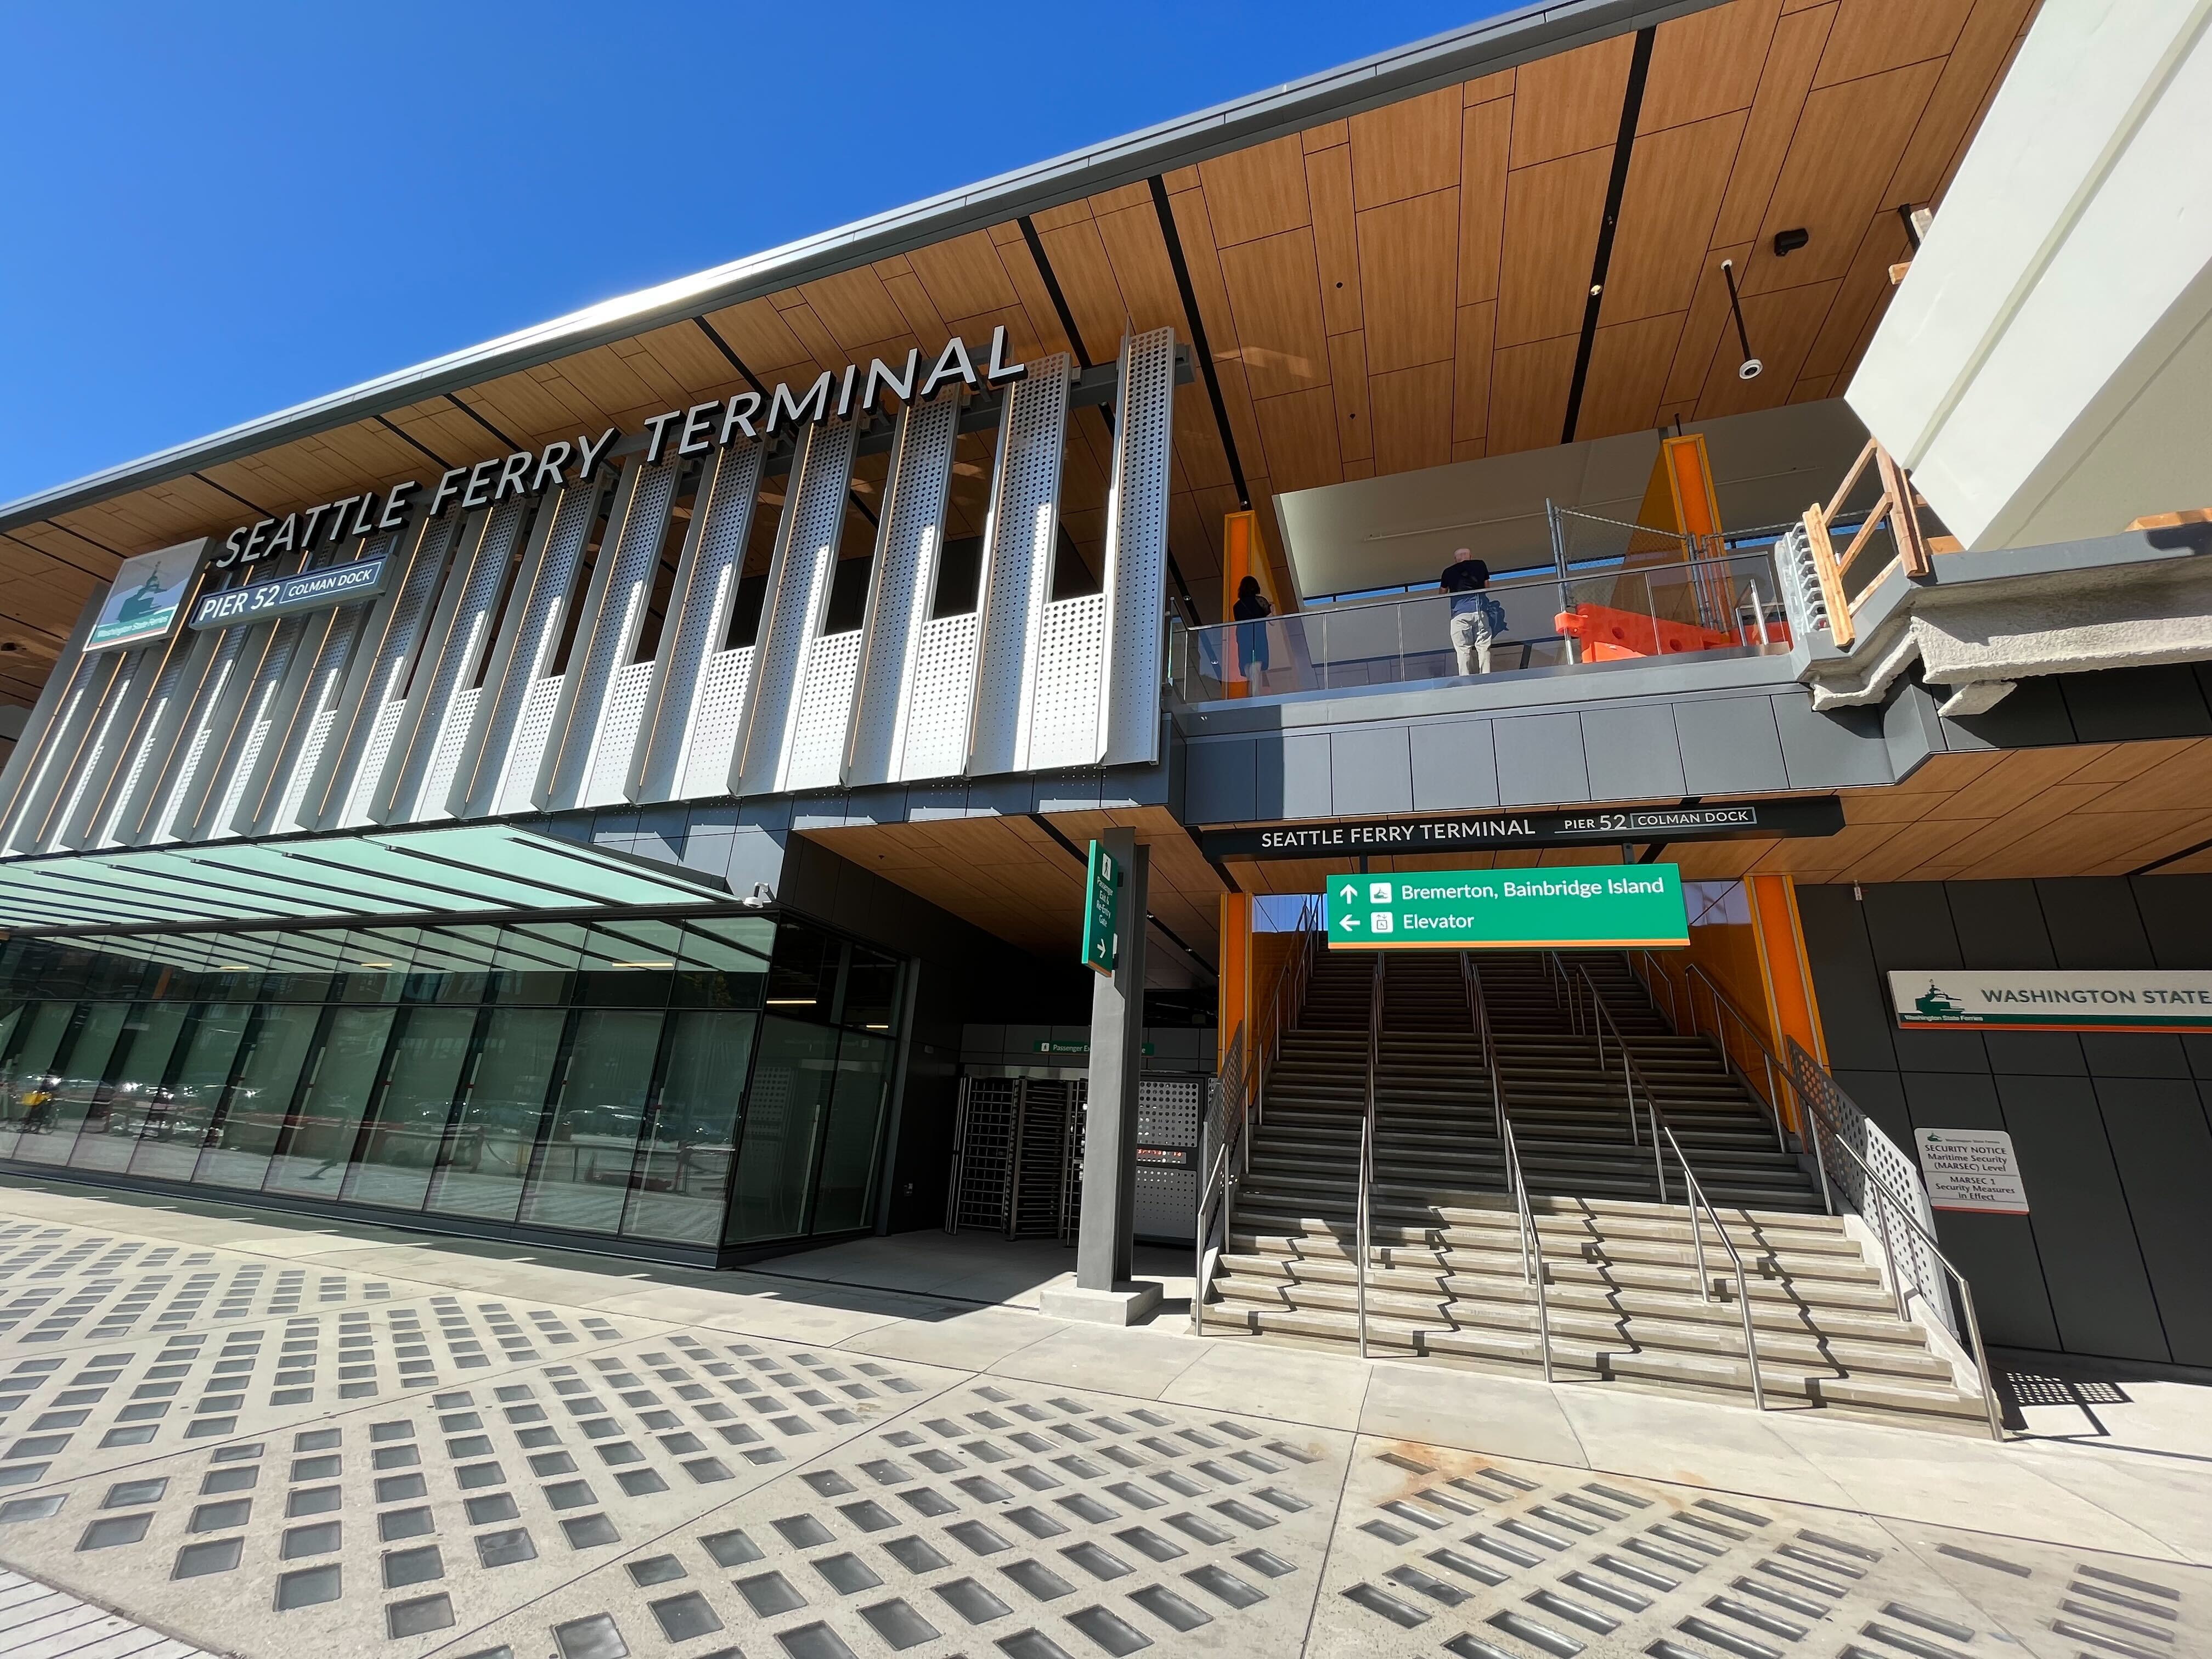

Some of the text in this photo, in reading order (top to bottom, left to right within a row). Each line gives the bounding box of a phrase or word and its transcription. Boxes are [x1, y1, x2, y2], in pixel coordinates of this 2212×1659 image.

[216, 325, 1025, 568] SEATTLE FERRY TERMINAL
[199, 568, 373, 622] PIER 52 COLMAN DOCK
[1564, 811, 1748, 830] PIER 52 COLMAN DOCK
[1261, 819, 1536, 848] SEATTLE FERRY TERMINAL
[1097, 876, 1113, 896] Passenger
[1402, 877, 1664, 900] Bremerton, Bainbridge Island
[1403, 913, 1475, 929] Elevator
[1980, 989, 2212, 1005] WASHINGTON STATE
[1053, 1044, 1083, 1053] Passenger
[1925, 1144, 2007, 1155] SECURITY NOTICE
[1927, 1153, 2007, 1165] Maritime Security
[1934, 1162, 1979, 1172] (MARSEC)
[1935, 1183, 2015, 1194] Security Measures
[1950, 1176, 1988, 1185] MARSEC
[1970, 1193, 1996, 1201] Effect
